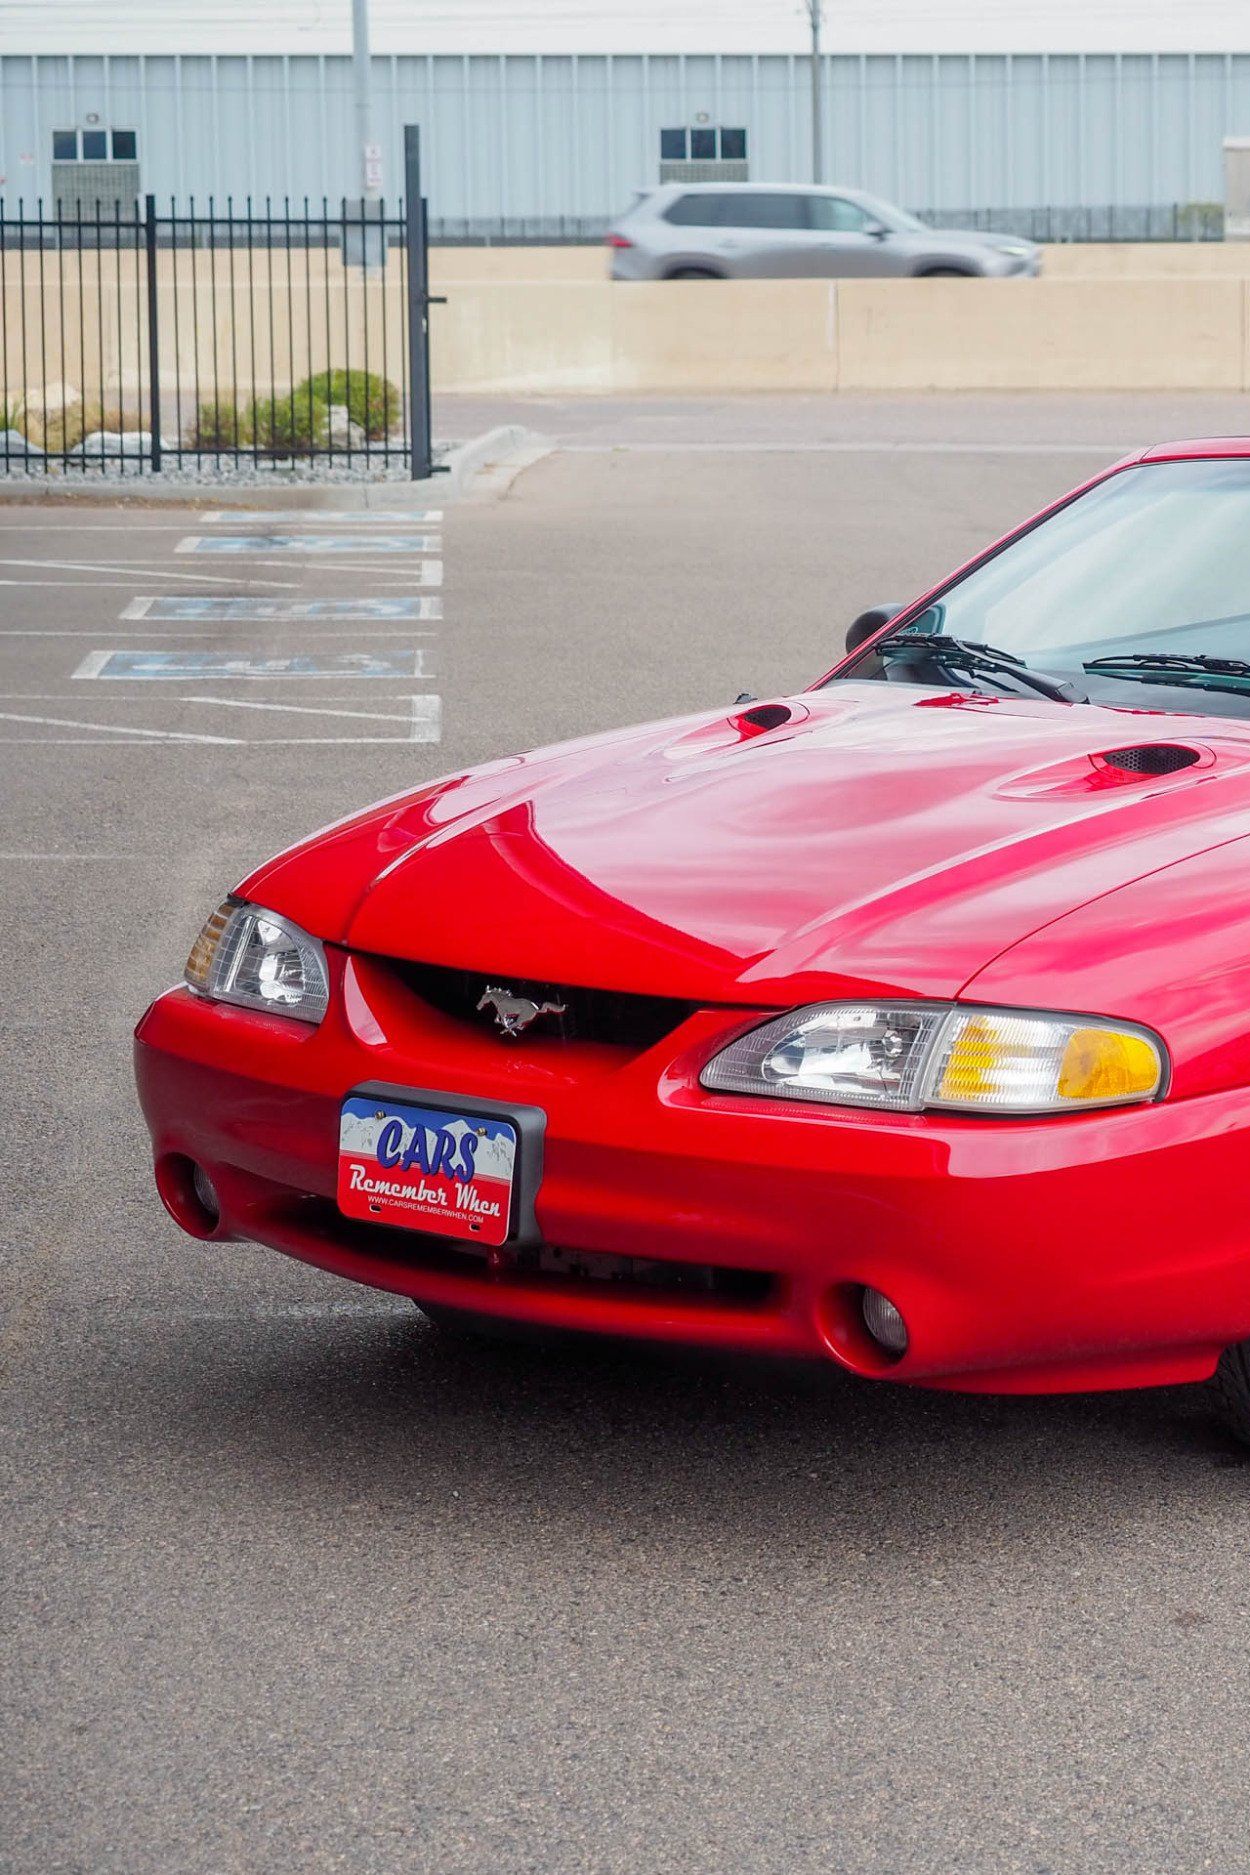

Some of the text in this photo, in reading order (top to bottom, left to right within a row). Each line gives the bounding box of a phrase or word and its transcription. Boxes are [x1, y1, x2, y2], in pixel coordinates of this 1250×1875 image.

[377, 1119, 479, 1184] CARS
[350, 1164, 501, 1217] Remember When
[367, 1195, 484, 1223] WWW.CARSREMEMBERWHEN.COM
